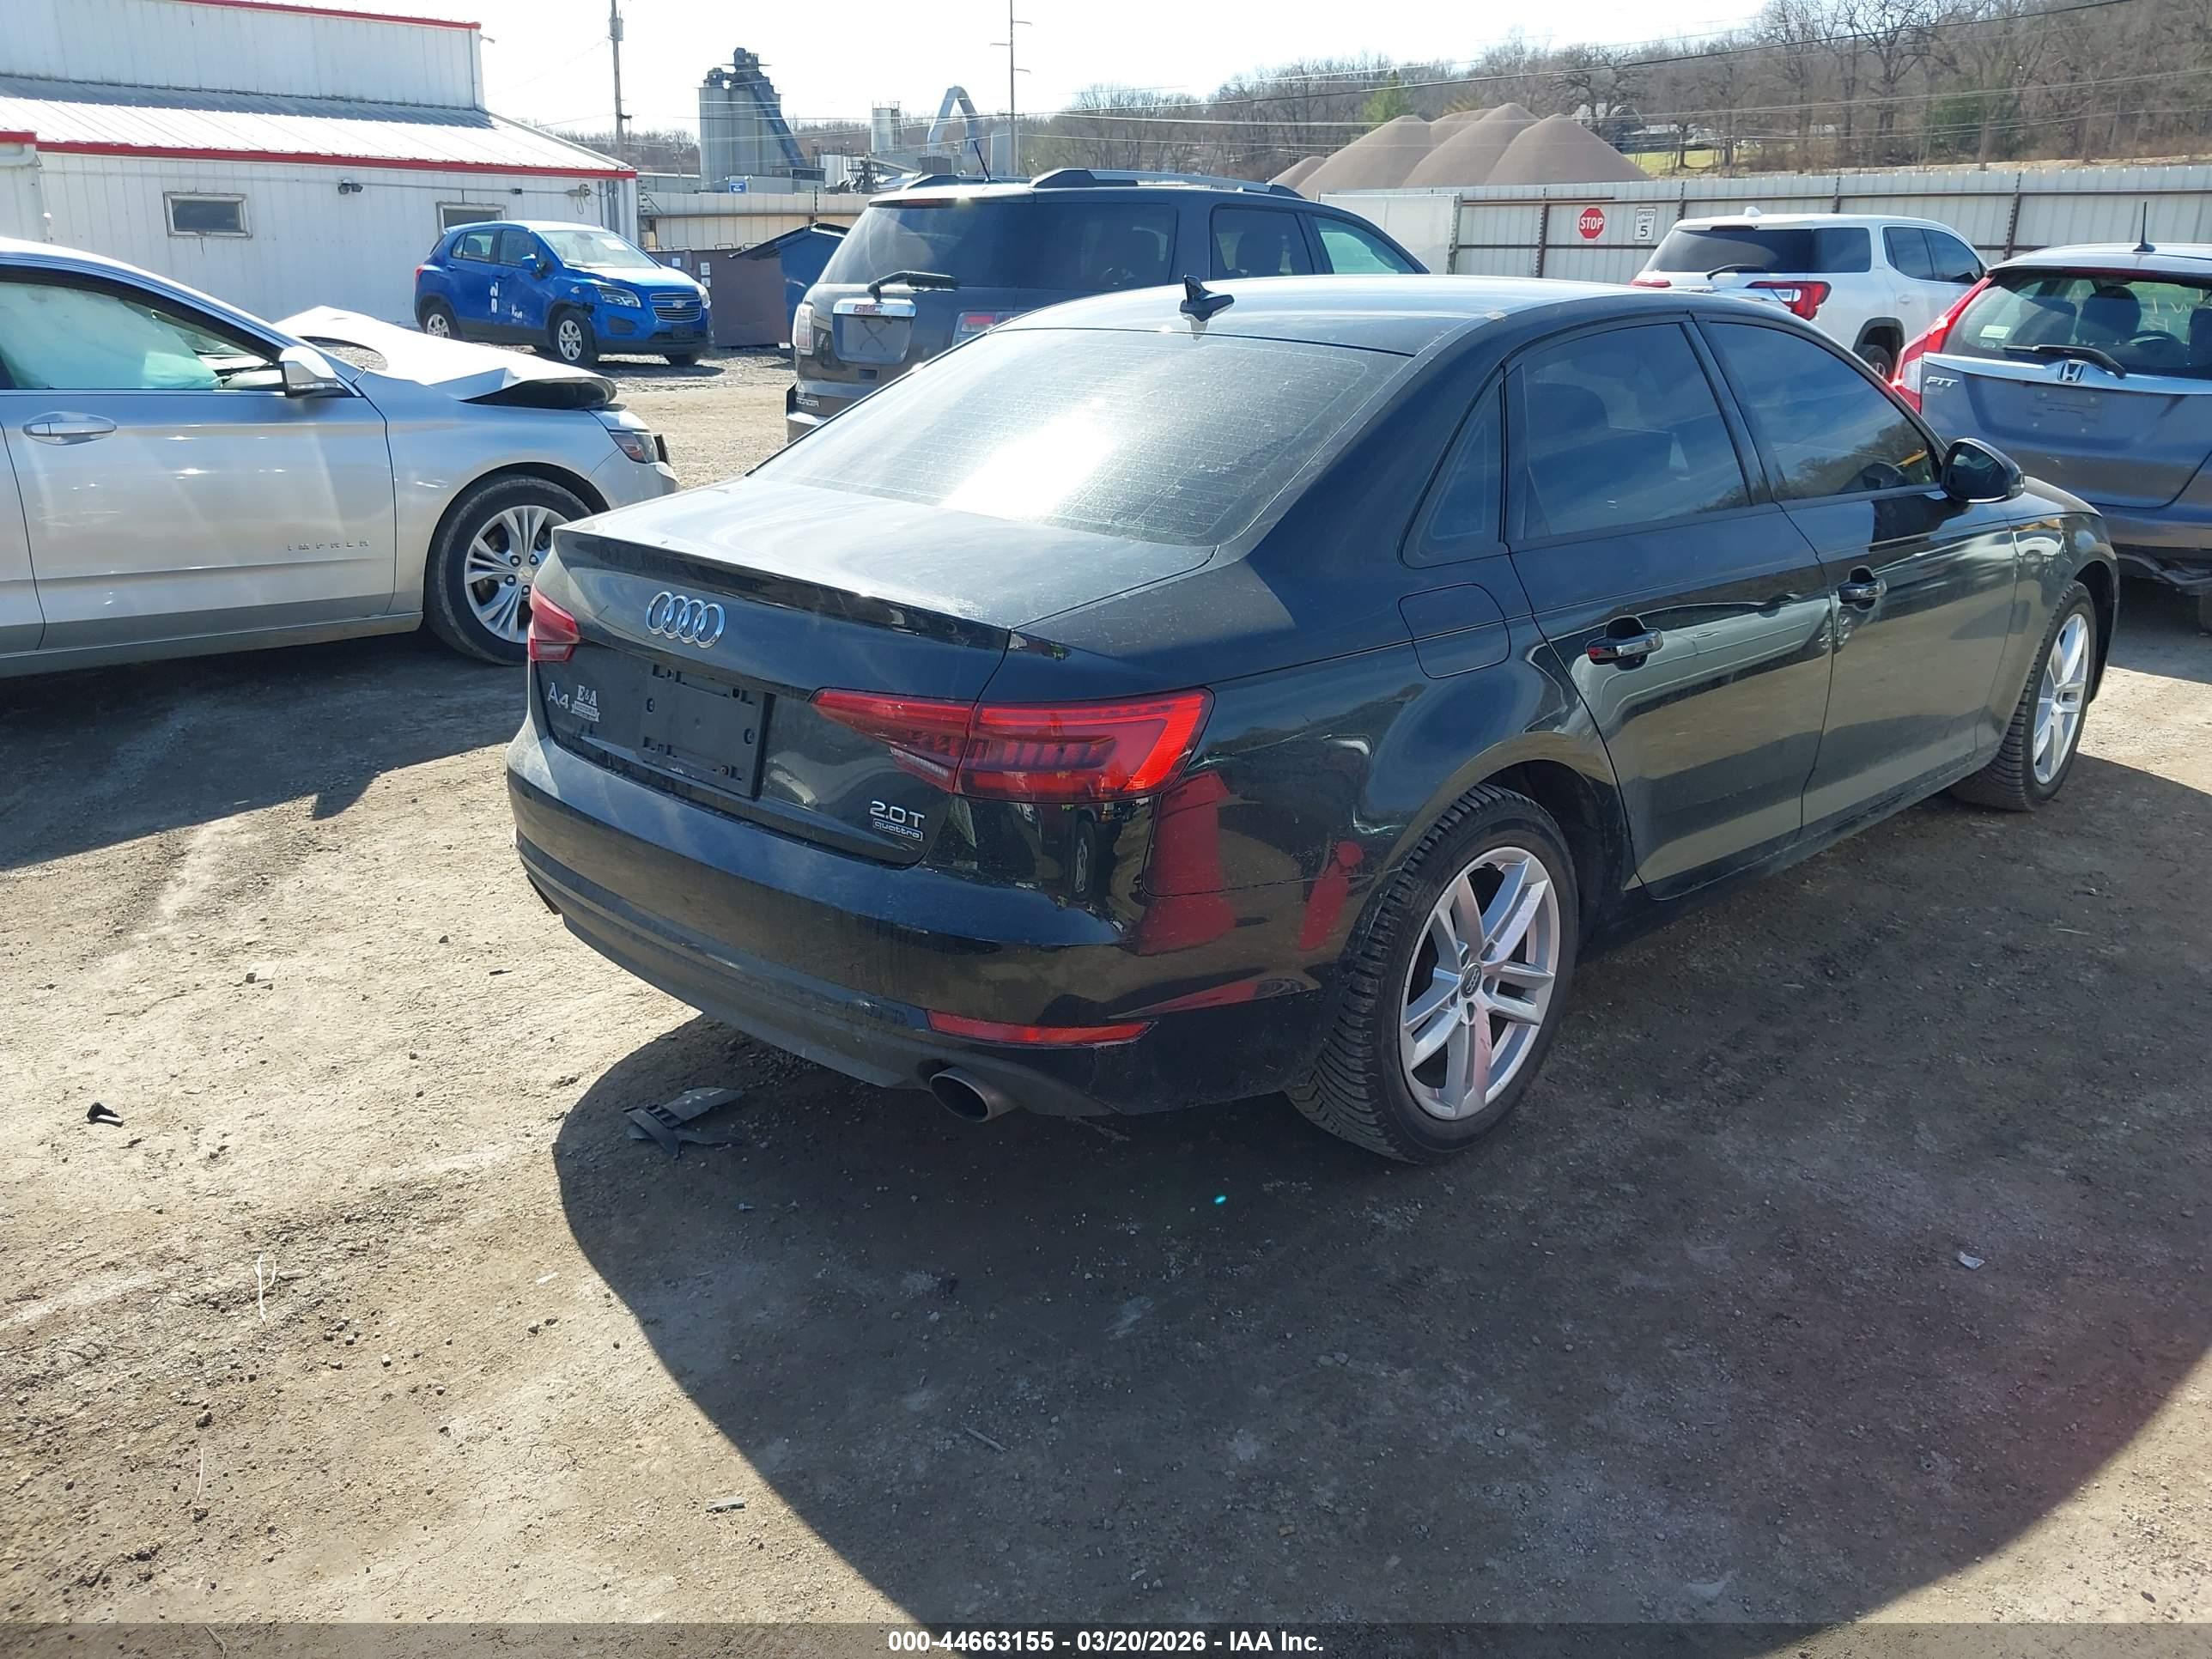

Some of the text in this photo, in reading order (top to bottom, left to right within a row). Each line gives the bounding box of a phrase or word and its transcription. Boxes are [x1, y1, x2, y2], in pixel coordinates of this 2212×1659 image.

[1580, 216, 1604, 230] STOP
[1639, 225, 1649, 237] 5
[854, 303, 884, 314] GMC
[1925, 375, 1960, 387] FIT
[287, 540, 369, 551] IMPALA
[548, 682, 569, 709] A4
[869, 800, 926, 829] 2.0T
[874, 821, 920, 839] quattro
